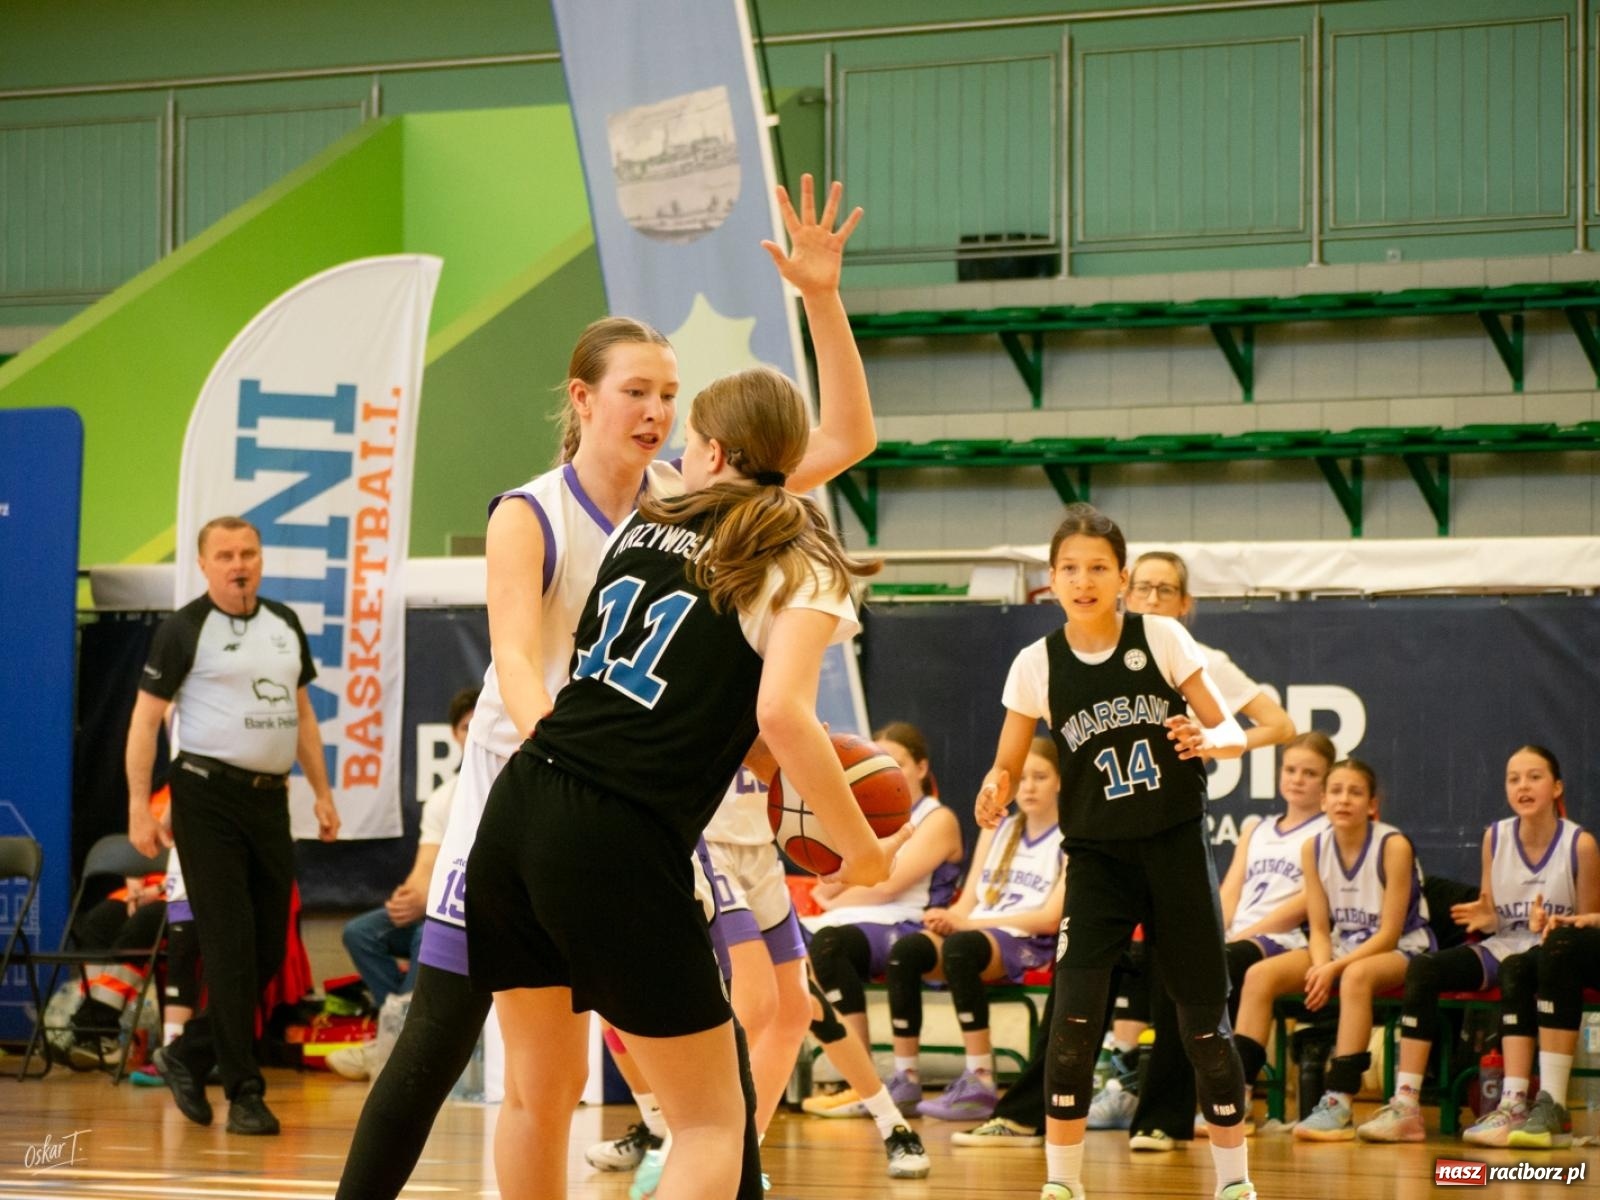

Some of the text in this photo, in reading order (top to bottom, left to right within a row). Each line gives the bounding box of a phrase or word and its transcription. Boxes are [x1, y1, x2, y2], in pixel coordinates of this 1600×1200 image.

[342, 386, 402, 790] BASKETBALL
[573, 575, 698, 710] 11
[244, 717, 274, 729] Bank
[1060, 695, 1169, 752] WARSAW
[1094, 739, 1161, 800] 14
[1482, 1080, 1499, 1098] G
